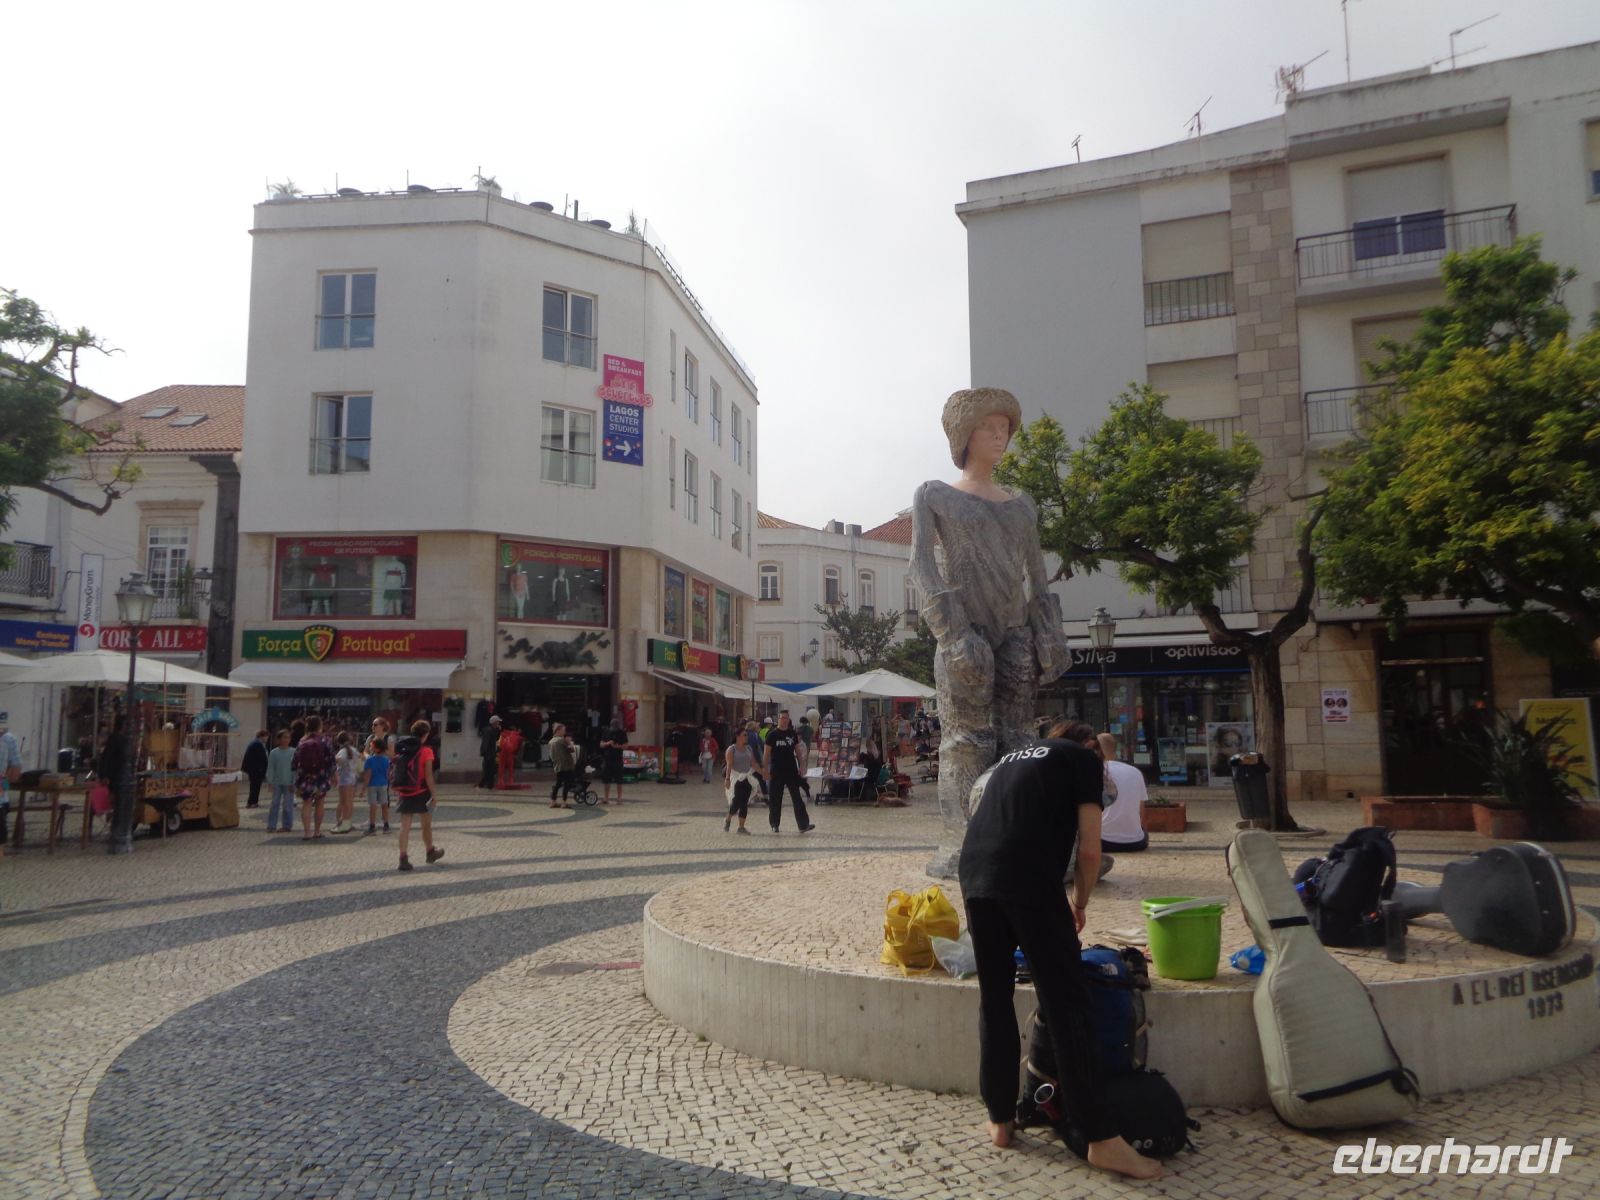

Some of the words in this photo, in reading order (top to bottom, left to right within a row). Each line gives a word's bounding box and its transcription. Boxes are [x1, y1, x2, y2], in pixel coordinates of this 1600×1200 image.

[608, 358, 619, 366] BED
[608, 364, 642, 377] BREAKFAST
[609, 404, 639, 418] LAGOS
[609, 414, 639, 426] CENTER
[609, 423, 640, 435] STUDIOS
[84, 570, 94, 622] MoneyGram
[152, 630, 183, 648] ALL
[258, 636, 301, 656] Força
[342, 635, 410, 656] Portugal
[1074, 648, 1117, 664] Silva
[278, 697, 306, 706] UEFA
[310, 697, 338, 706] EURO
[341, 697, 368, 706] 2016
[1453, 982, 1465, 1005] A
